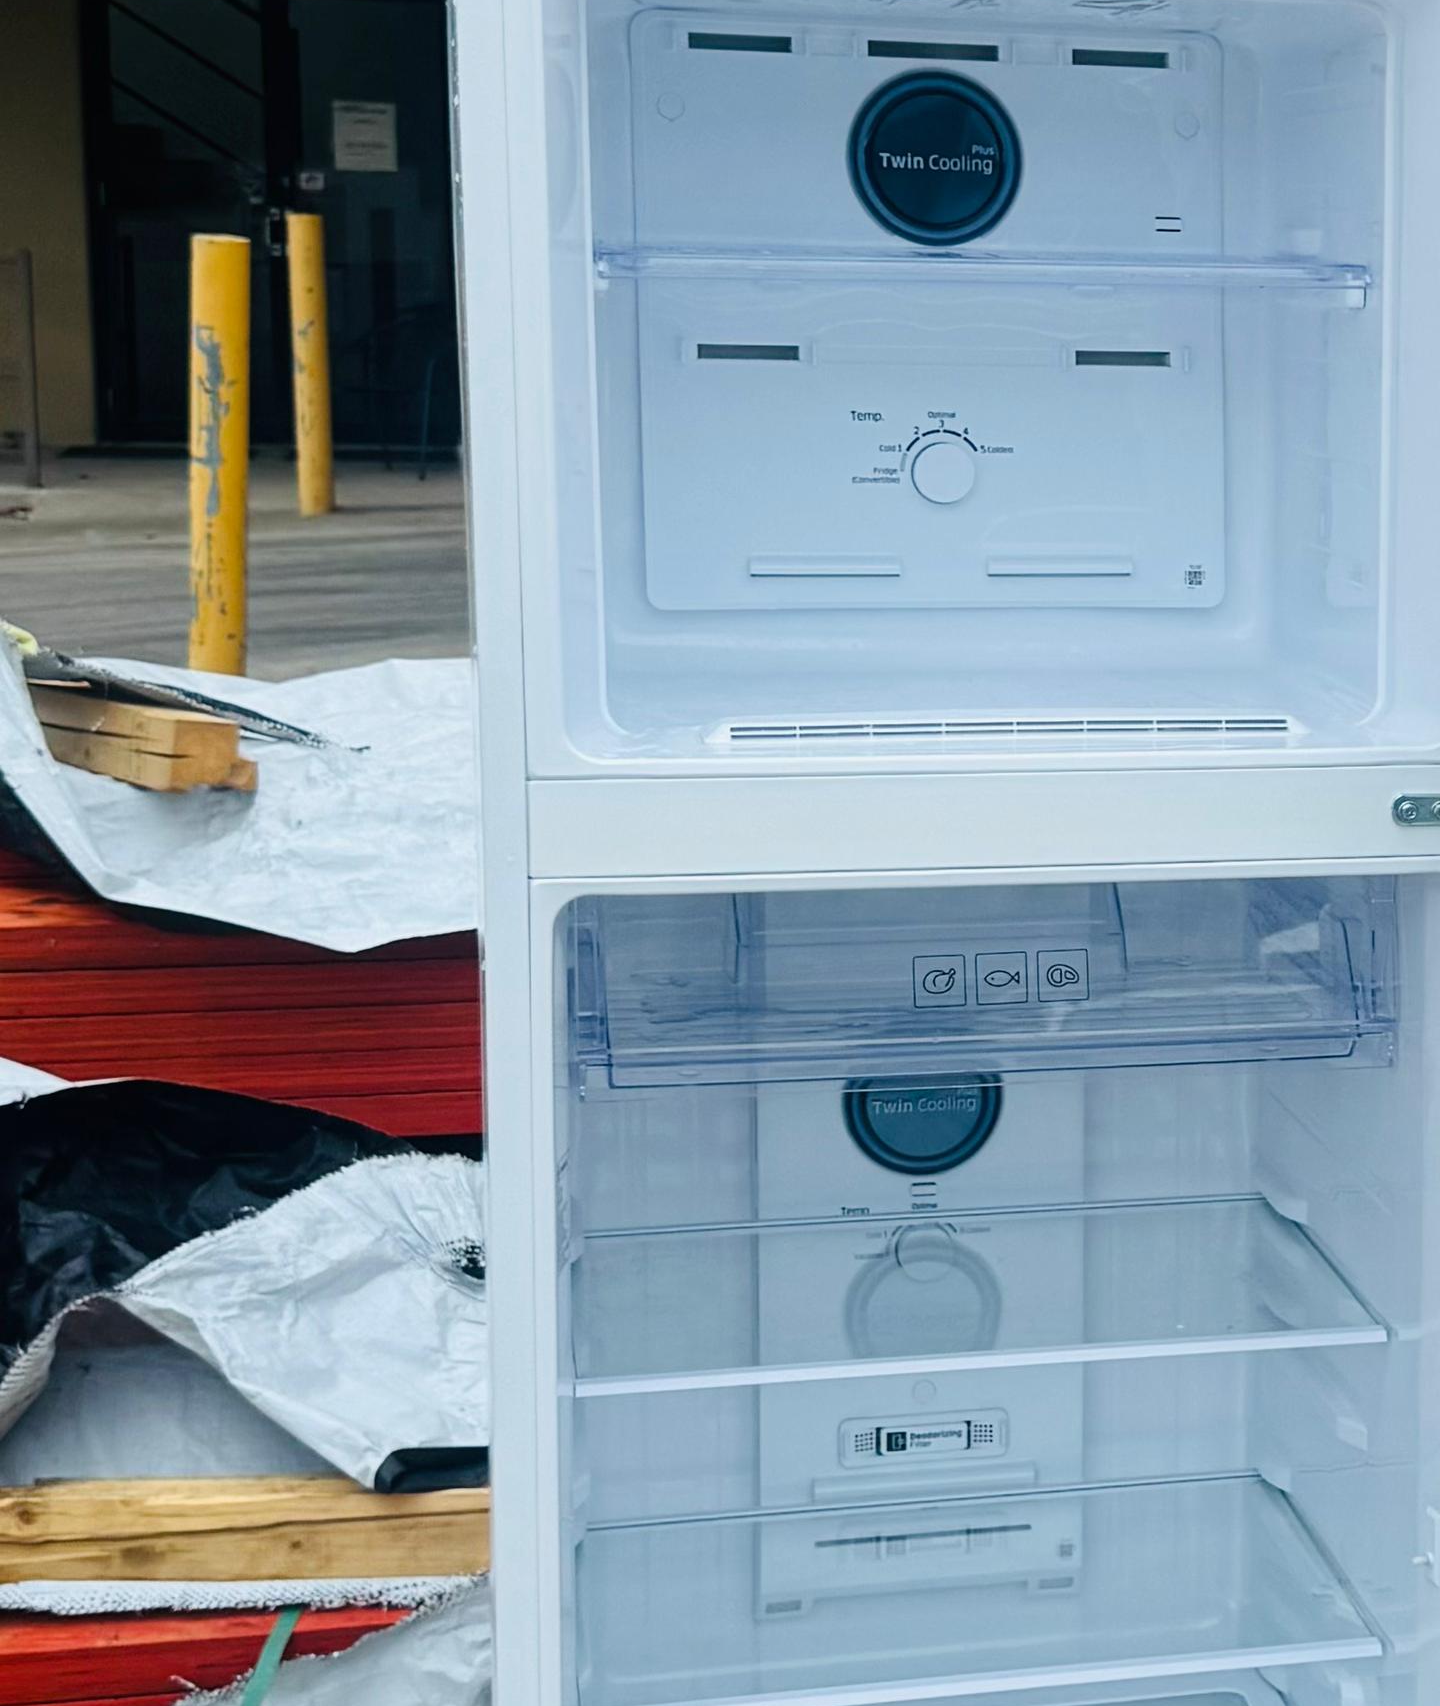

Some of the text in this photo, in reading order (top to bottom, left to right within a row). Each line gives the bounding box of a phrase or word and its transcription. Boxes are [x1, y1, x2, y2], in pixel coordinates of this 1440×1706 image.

[972, 144, 995, 155] Plus
[878, 152, 994, 175] Twin Cooling
[850, 410, 885, 423] Temp.
[938, 419, 945, 428] 3
[913, 425, 920, 435] 2
[963, 427, 969, 435] 4
[980, 445, 987, 454] 5
[873, 467, 898, 475] Fridge
[872, 1095, 977, 1114] Twin Cooling
